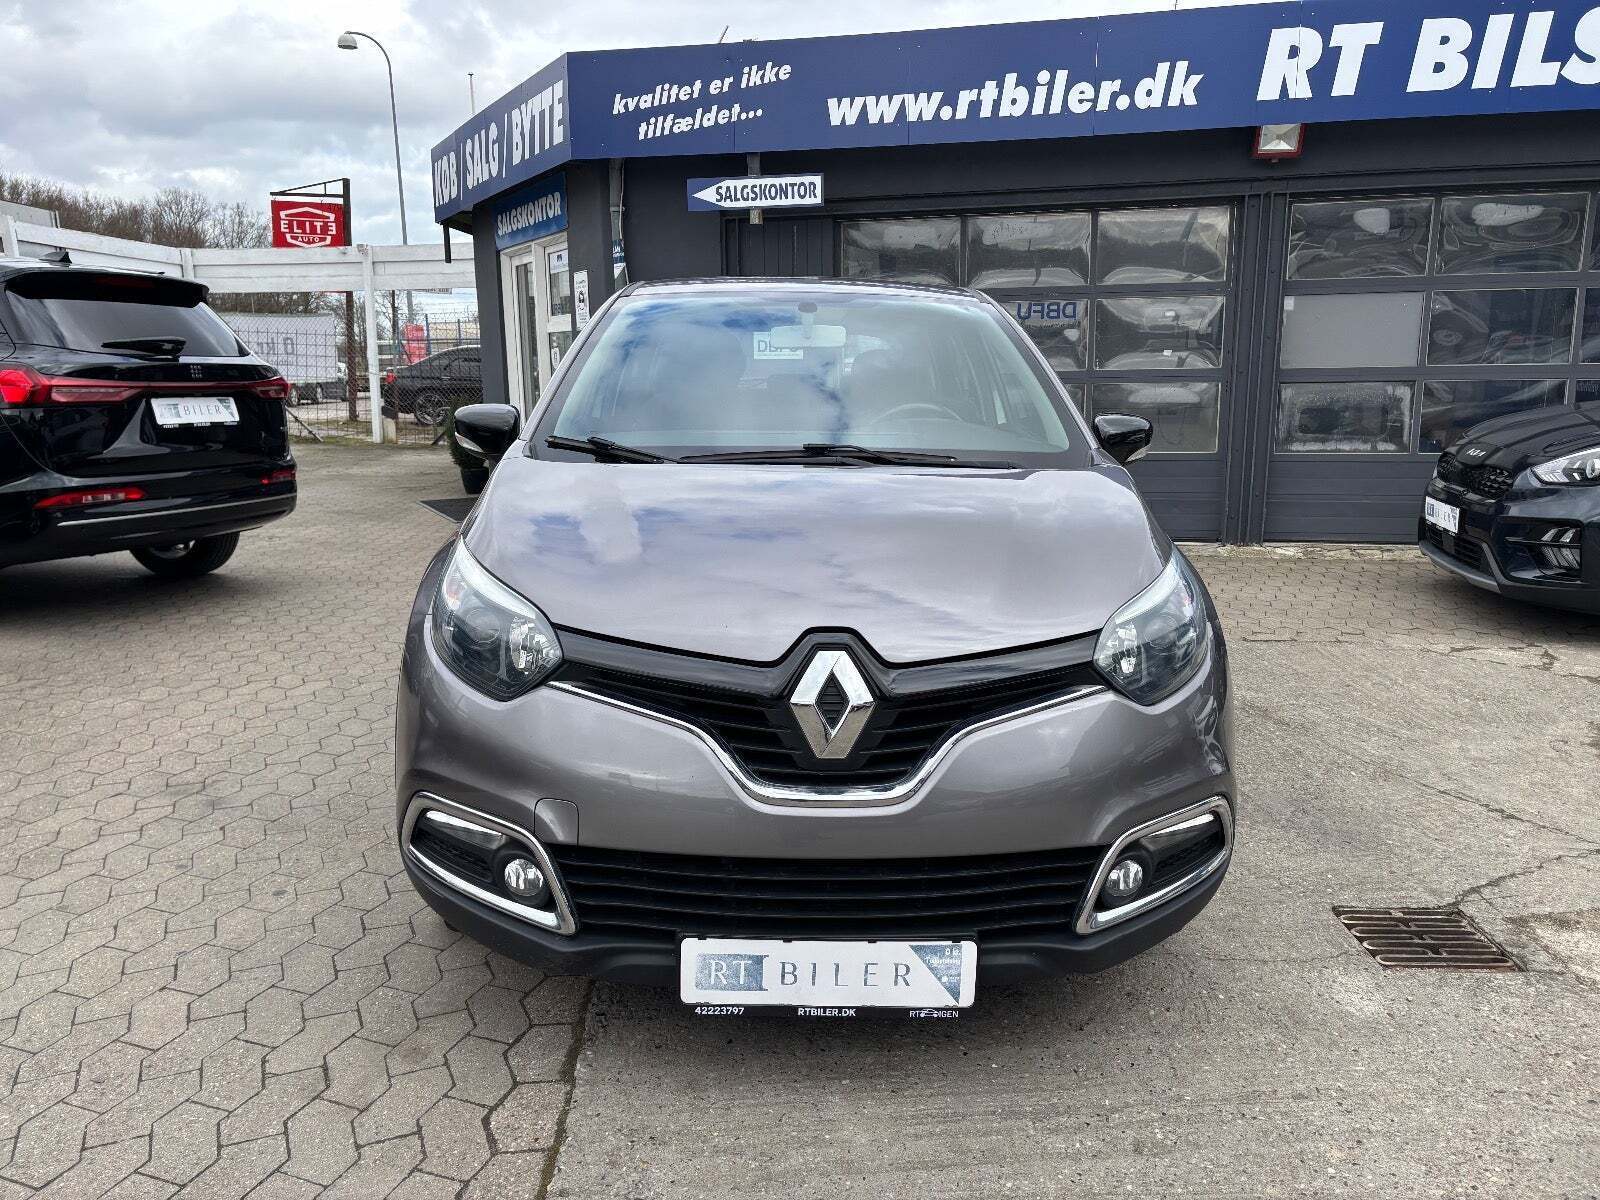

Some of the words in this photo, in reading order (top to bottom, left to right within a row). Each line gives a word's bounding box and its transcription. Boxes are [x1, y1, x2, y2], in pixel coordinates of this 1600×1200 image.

[1256, 22, 1384, 101] RT
[1405, 6, 1600, 93] BILS
[612, 79, 702, 115] kvalitet
[709, 73, 735, 95] er
[740, 61, 792, 89] ikke
[827, 60, 1204, 126] www.rtbiler.dk
[638, 103, 763, 141] tilfældet...
[434, 151, 458, 208] KØB
[465, 121, 499, 190] SALG
[511, 79, 564, 167] BYTTE
[715, 181, 818, 203] SALGSKONTOR
[280, 220, 337, 235] ELITE
[497, 191, 562, 236] SALGSKONTOR
[297, 235, 320, 243] AUTO
[709, 960, 753, 986] RT
[779, 961, 911, 988] BILER
[694, 1006, 745, 1016] 42223797
[797, 1007, 857, 1018] RTBILER.DK
